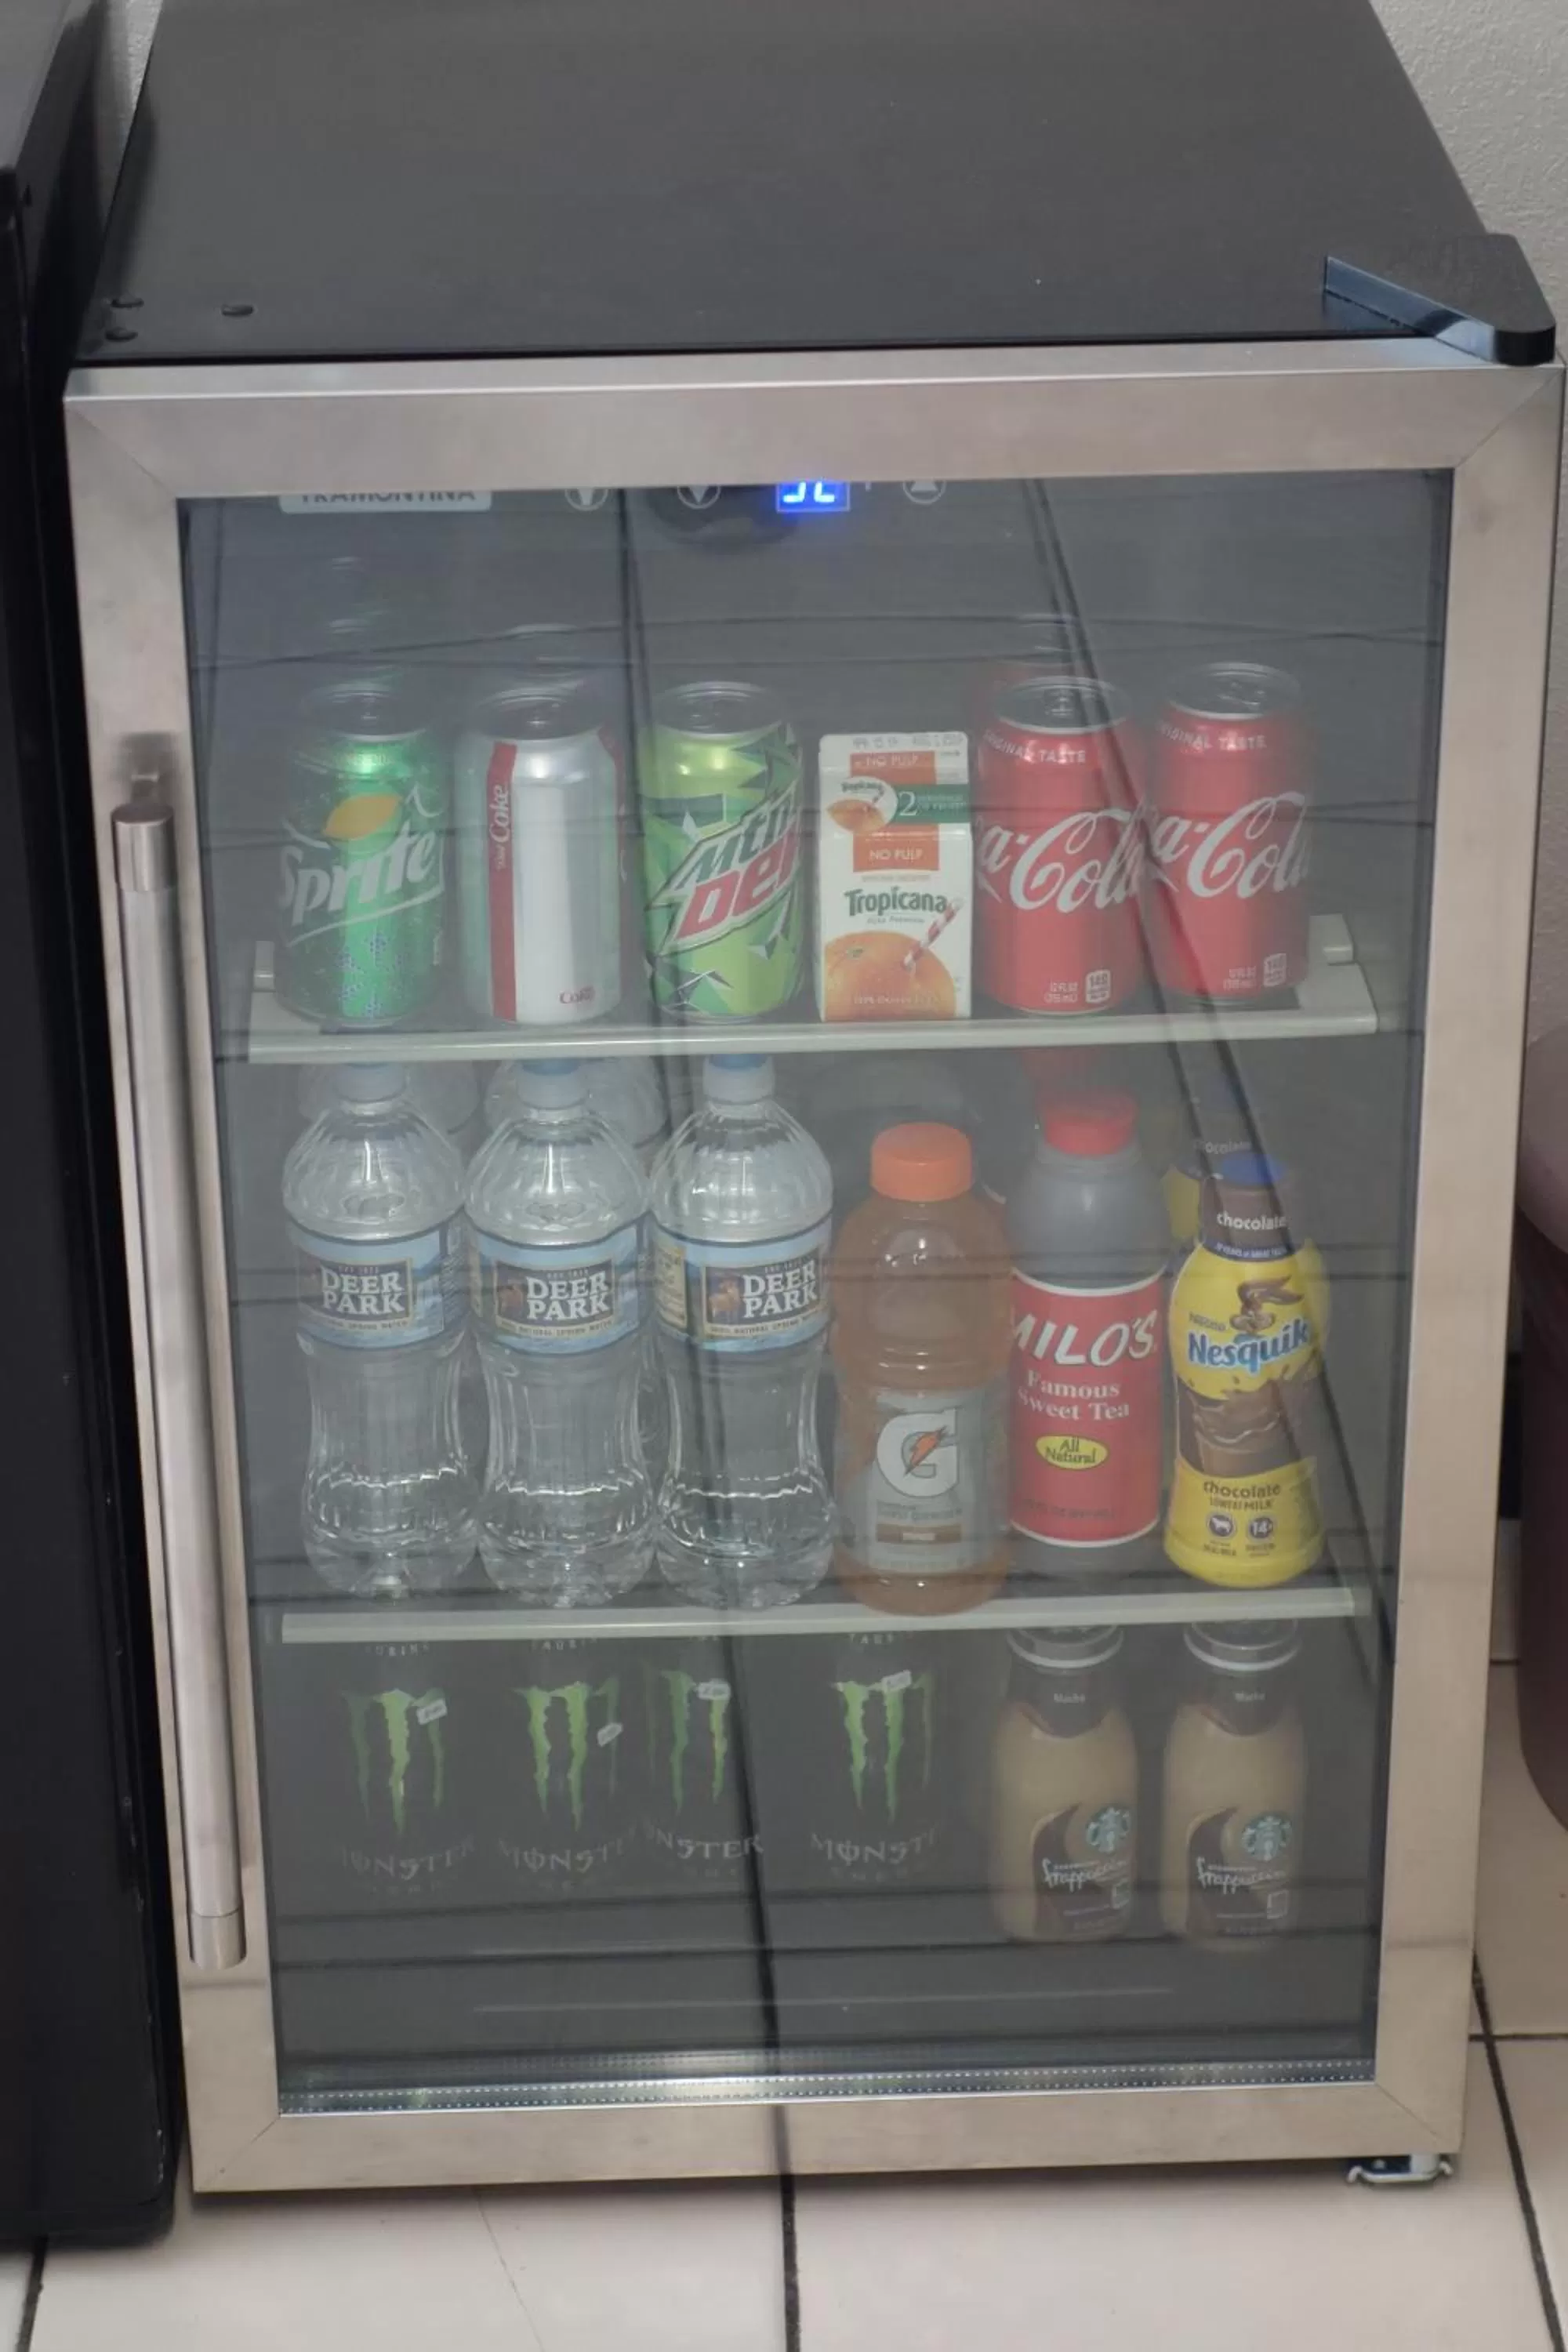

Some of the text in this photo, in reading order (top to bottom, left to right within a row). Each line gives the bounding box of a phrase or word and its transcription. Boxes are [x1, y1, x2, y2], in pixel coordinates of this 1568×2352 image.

[1040, 749, 1086, 764] TASTE
[1219, 735, 1267, 750] TASTE
[489, 784, 511, 844] Coke
[899, 791, 917, 816] 2
[869, 848, 924, 861] NO PULP
[279, 819, 437, 927] Sprite
[844, 885, 947, 916] Tropicana
[1216, 1211, 1287, 1230] chocolate
[321, 1265, 405, 1294] DEER
[526, 1269, 612, 1301] DEER
[742, 1259, 816, 1298] DEER
[321, 1290, 406, 1316] PARK
[526, 1291, 612, 1320] PARK
[743, 1281, 818, 1319] PARK
[1187, 1319, 1308, 1373] Nesquik
[1028, 1370, 1120, 1399] Famous
[1018, 1387, 1130, 1421] Sweet Tea
[876, 1408, 959, 1498] G
[1045, 1446, 1096, 1465] Natural
[1059, 1436, 1080, 1452] All
[1203, 1481, 1281, 1498] chocolate
